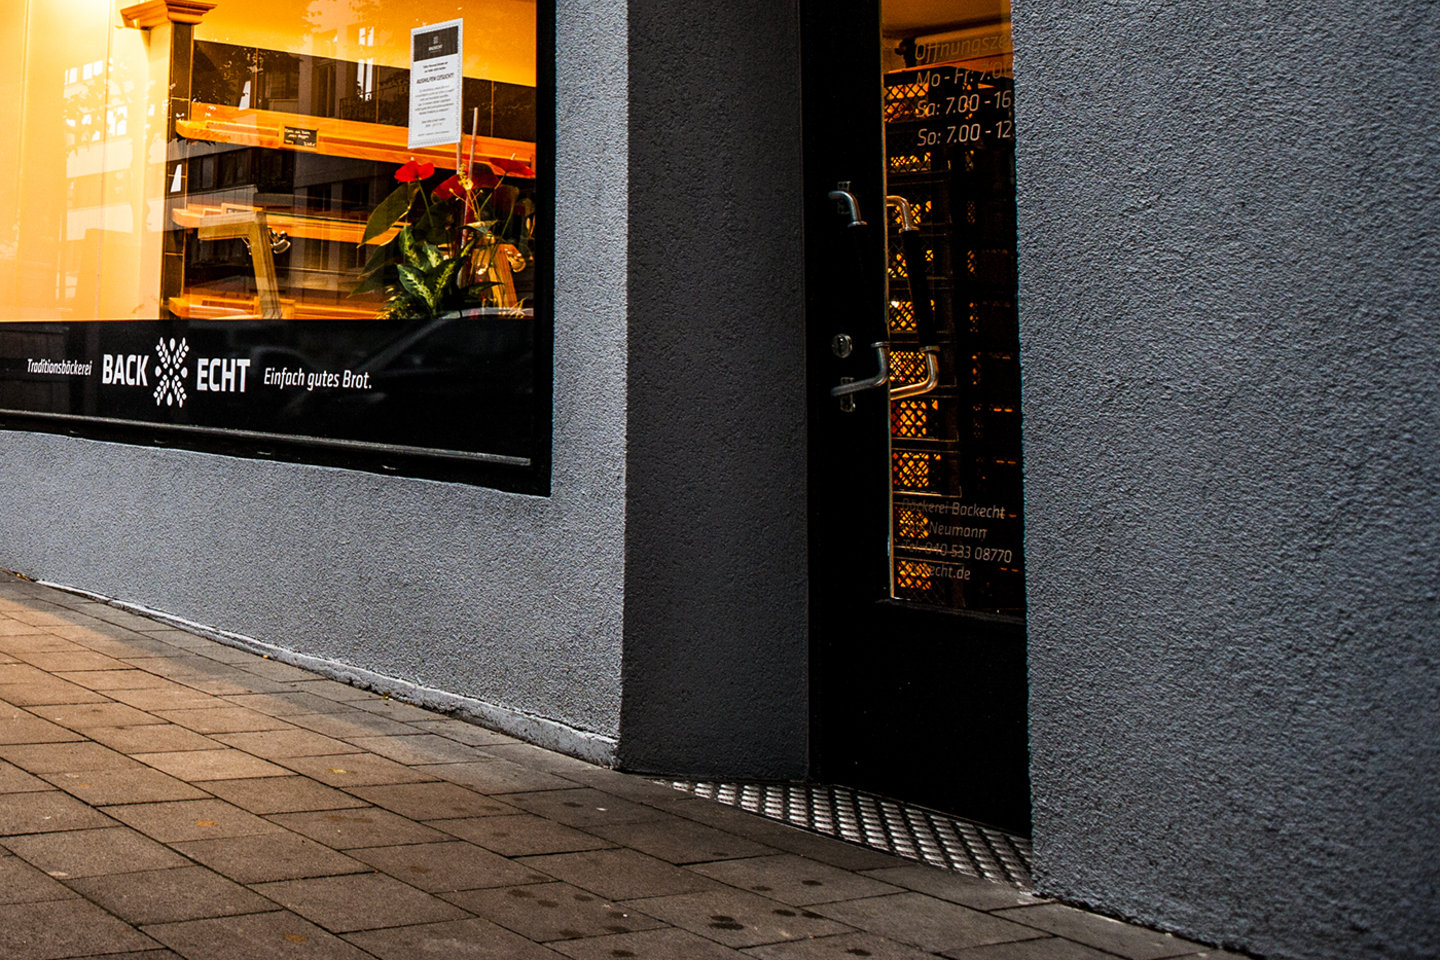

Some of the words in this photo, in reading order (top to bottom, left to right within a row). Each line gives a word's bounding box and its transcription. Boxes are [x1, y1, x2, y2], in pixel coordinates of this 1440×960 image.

[916, 70, 941, 87] Mo
[916, 98, 940, 118] Sa:
[945, 93, 980, 115] 7.00
[916, 128, 941, 146] So:
[946, 123, 981, 144] 7.00
[27, 358, 93, 376] Traditionsbäckerei
[102, 354, 149, 386] BACK
[196, 358, 251, 392] ECHT
[263, 367, 305, 390] Einfach
[307, 370, 340, 391] gutes
[342, 369, 372, 389] Brot.
[928, 520, 987, 539] Neumann
[951, 544, 971, 559] 533
[974, 546, 1013, 564] 08770
